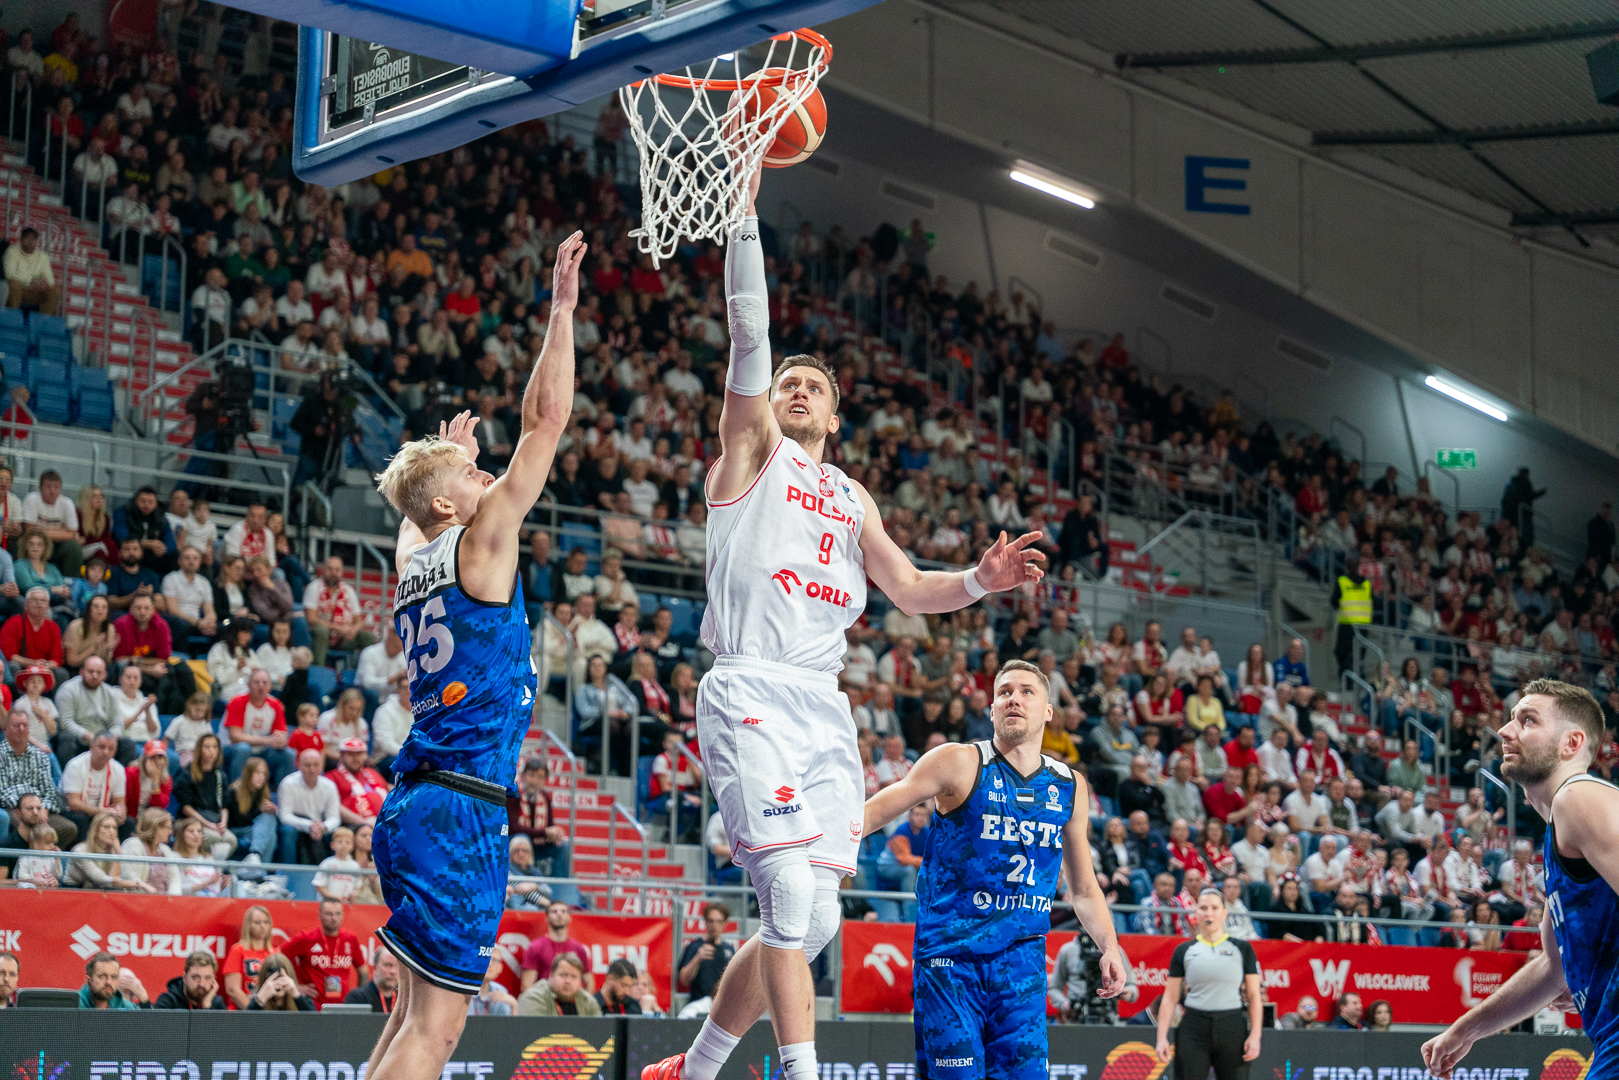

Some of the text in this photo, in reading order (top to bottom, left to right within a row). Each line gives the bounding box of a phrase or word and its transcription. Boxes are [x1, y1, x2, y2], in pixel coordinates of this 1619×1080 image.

[1185, 155, 1251, 215] E
[818, 532, 834, 565] 9
[400, 595, 455, 684] 25
[988, 791, 1008, 804] BALLZY
[1007, 854, 1036, 886] 21
[107, 931, 227, 959] SUZUKI
[310, 954, 353, 970] POLSKA
[930, 957, 955, 968] BALLZY
[1353, 972, 1430, 992] WŁOCŁAWEK
[935, 1057, 974, 1068] RAMIRENT
